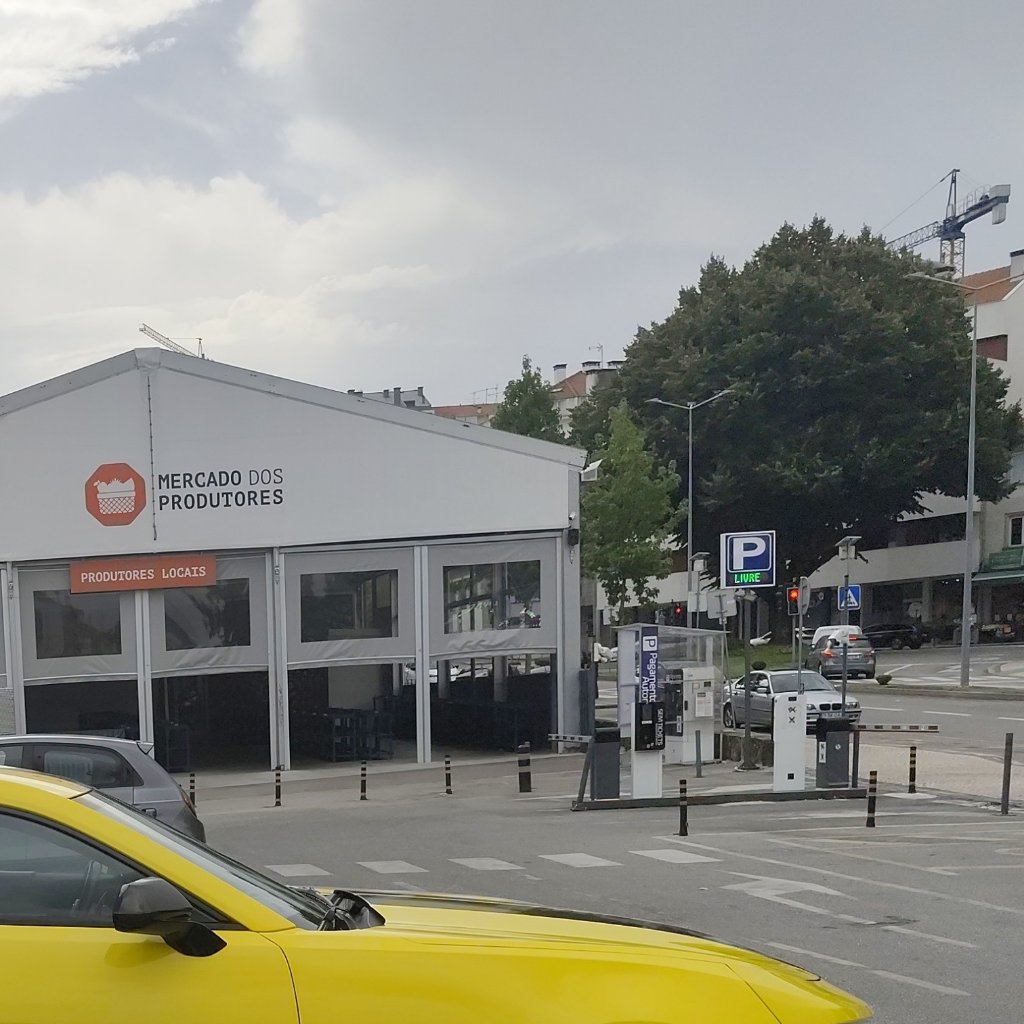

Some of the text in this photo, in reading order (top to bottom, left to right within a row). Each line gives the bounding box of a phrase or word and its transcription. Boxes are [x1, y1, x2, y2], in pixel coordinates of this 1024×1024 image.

[158, 468, 284, 490] MERCADO DOS
[159, 489, 284, 511] PRODUTORES
[733, 537, 766, 570] P
[81, 566, 206, 583] PRODUTORES LOCAIS
[734, 572, 761, 584] LIVRE
